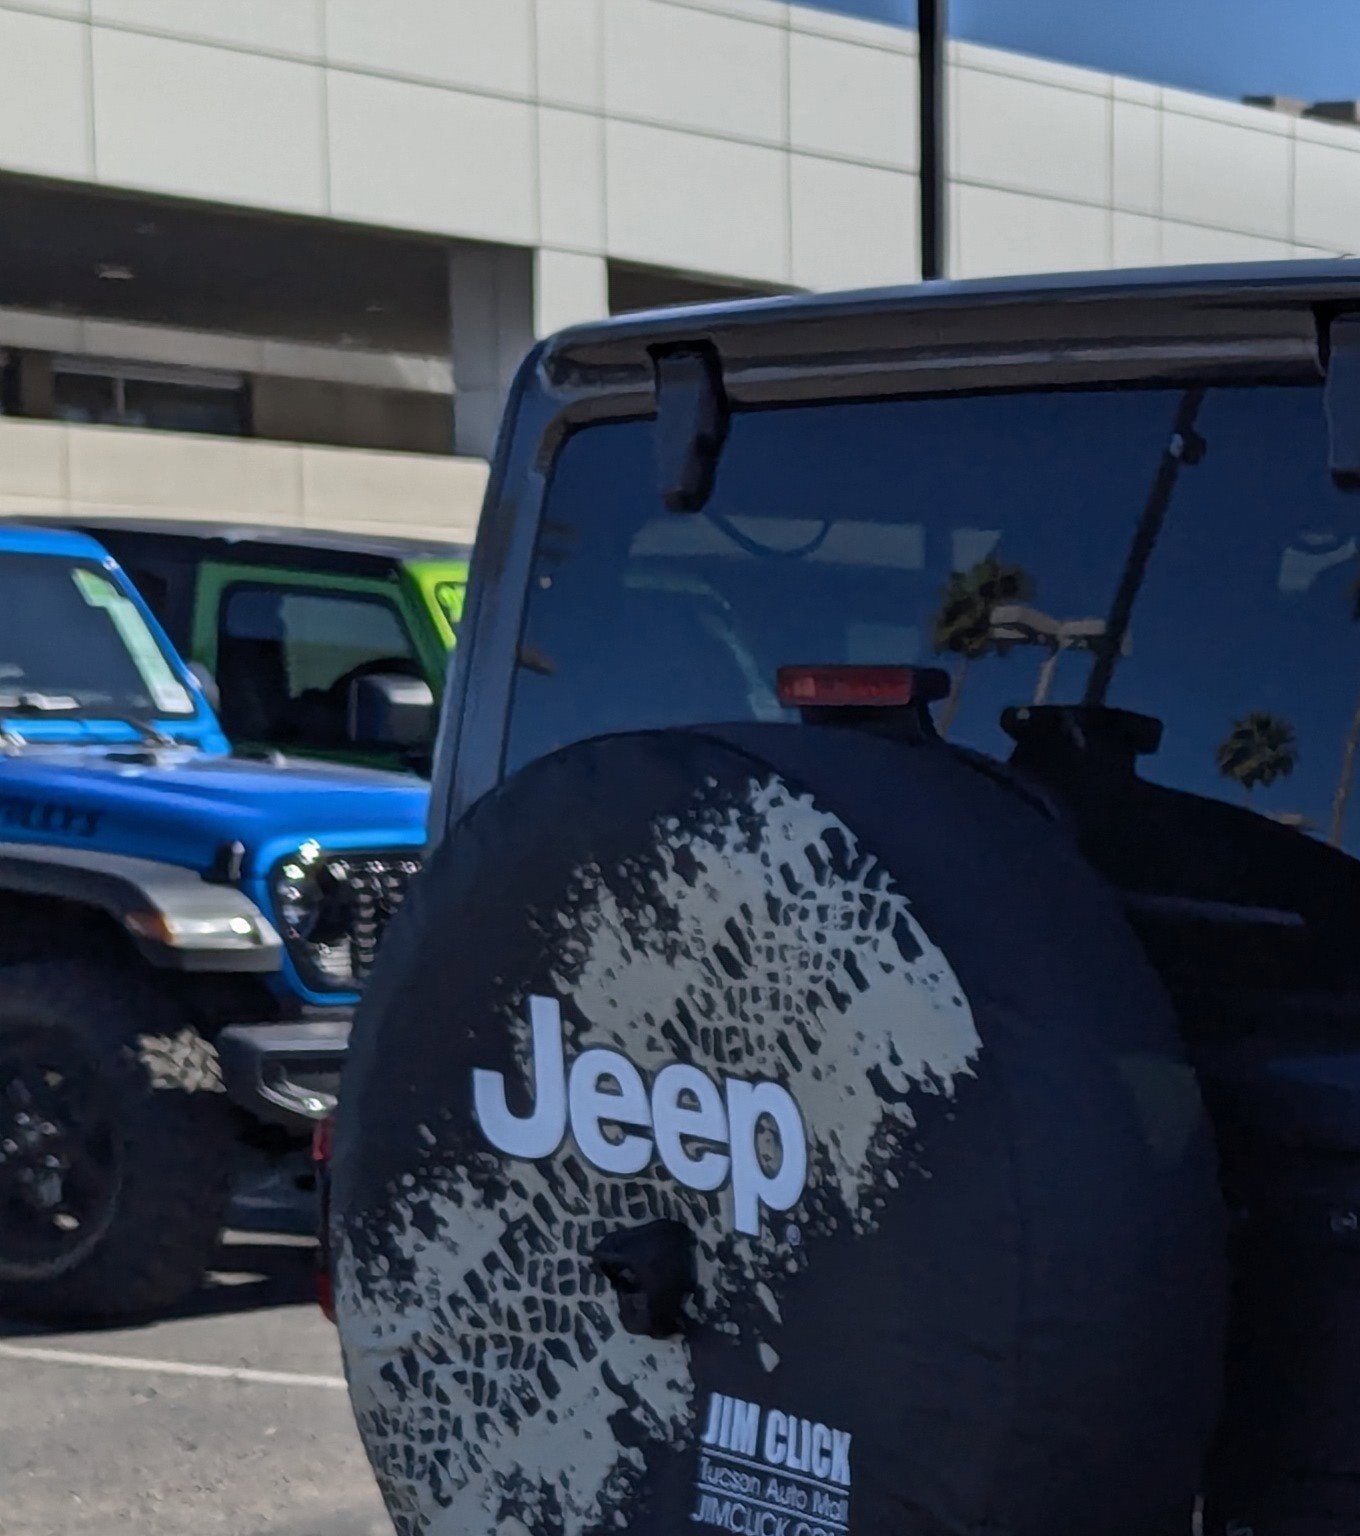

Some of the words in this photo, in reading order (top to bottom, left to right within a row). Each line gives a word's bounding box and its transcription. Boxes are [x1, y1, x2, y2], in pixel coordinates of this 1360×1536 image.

[473, 994, 807, 1236] Jeep
[701, 1391, 761, 1457] JIM
[763, 1408, 852, 1486] CLICK
[701, 1456, 762, 1496] Tucson
[765, 1478, 808, 1510] Auto
[812, 1490, 849, 1521] Mall
